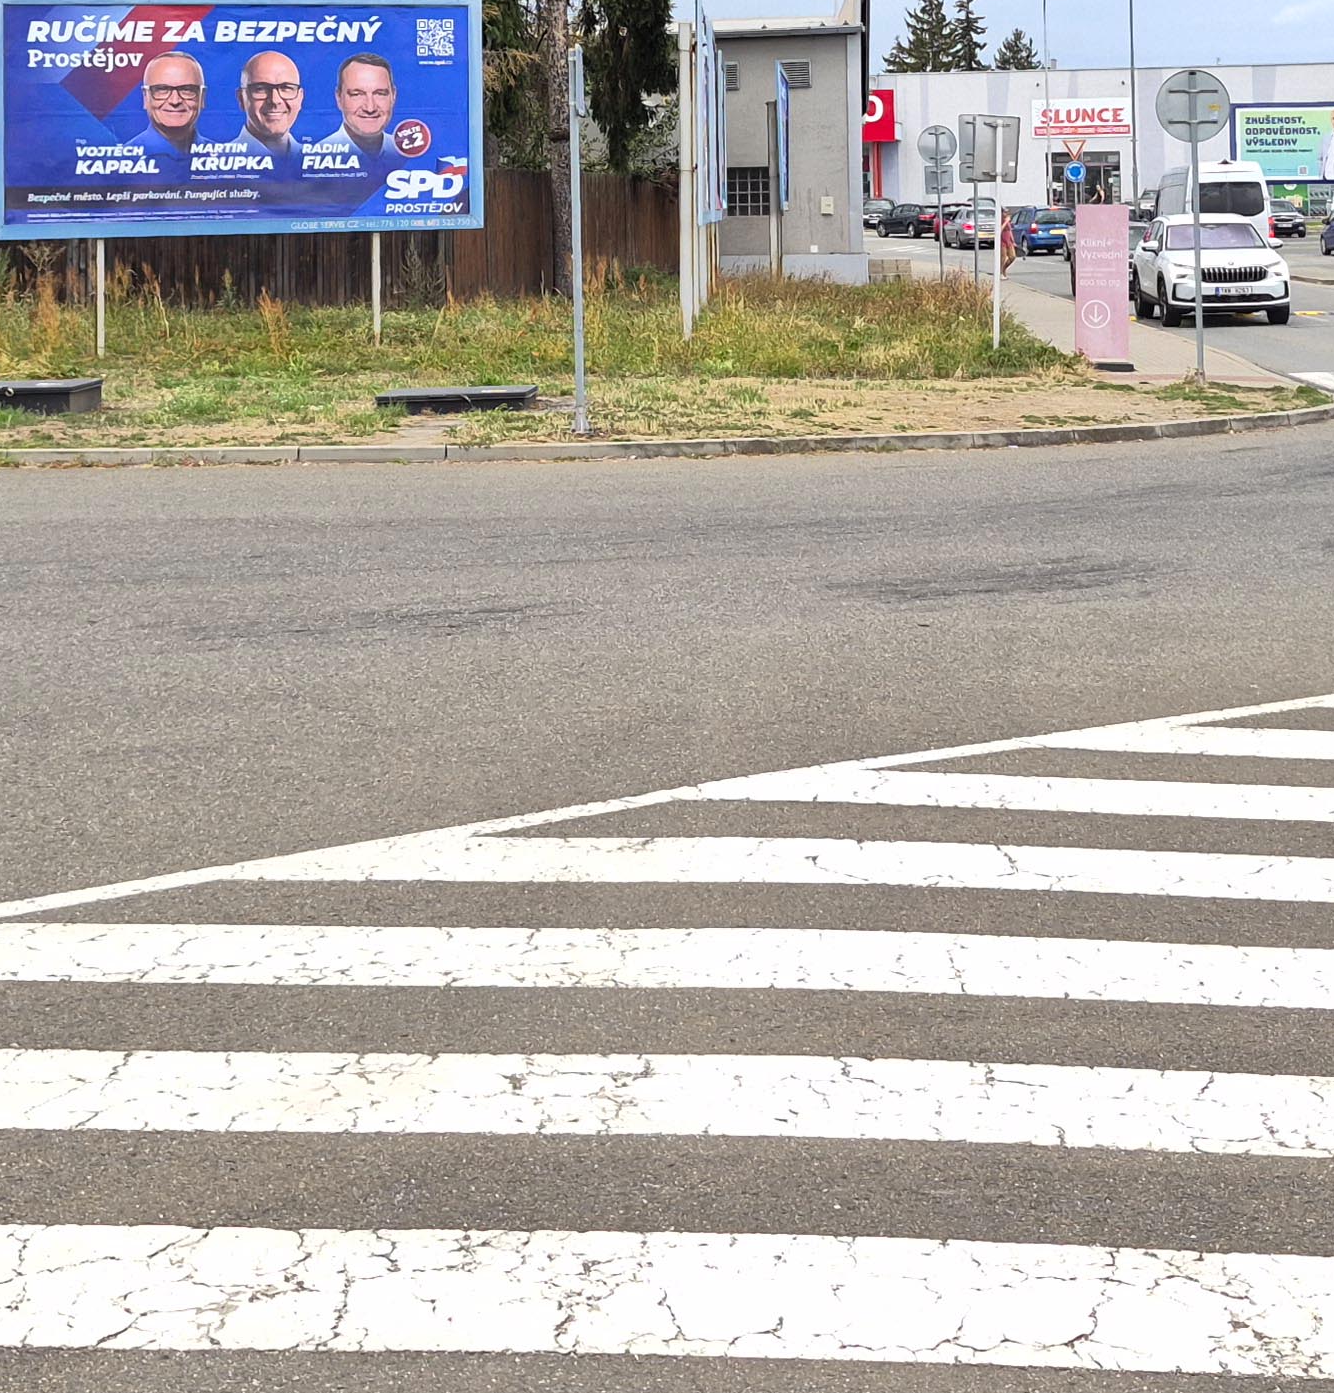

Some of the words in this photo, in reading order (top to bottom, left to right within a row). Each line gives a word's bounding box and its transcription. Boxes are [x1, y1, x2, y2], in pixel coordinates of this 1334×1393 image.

[27, 15, 155, 43] RUČÍME
[161, 20, 206, 43] ZA
[214, 15, 382, 43] BEZPEČNÝ
[27, 48, 144, 72] Prostějov
[1040, 107, 1125, 125] SLUNCE
[397, 126, 421, 138] VOLTE
[1245, 125, 1321, 136] ODPOVĚDNOST,
[76, 144, 144, 157] VOJTĚCH
[190, 143, 248, 154] MARTIN
[302, 143, 350, 154] RADIM
[75, 158, 160, 175] KAPRÁL
[190, 153, 274, 171] KŘUPKA
[302, 155, 361, 169] FIALA
[384, 169, 464, 200] SPD
[27, 192, 71, 203] Bezpečné
[73, 192, 104, 201] město.
[106, 191, 131, 202] Lepší
[132, 190, 182, 202] parkování.
[185, 189, 227, 201] Fungující
[229, 190, 260, 200] služby.
[385, 201, 464, 214] PROSTĚJOV
[291, 221, 317, 229] GLOBE
[347, 220, 360, 228] CZ
